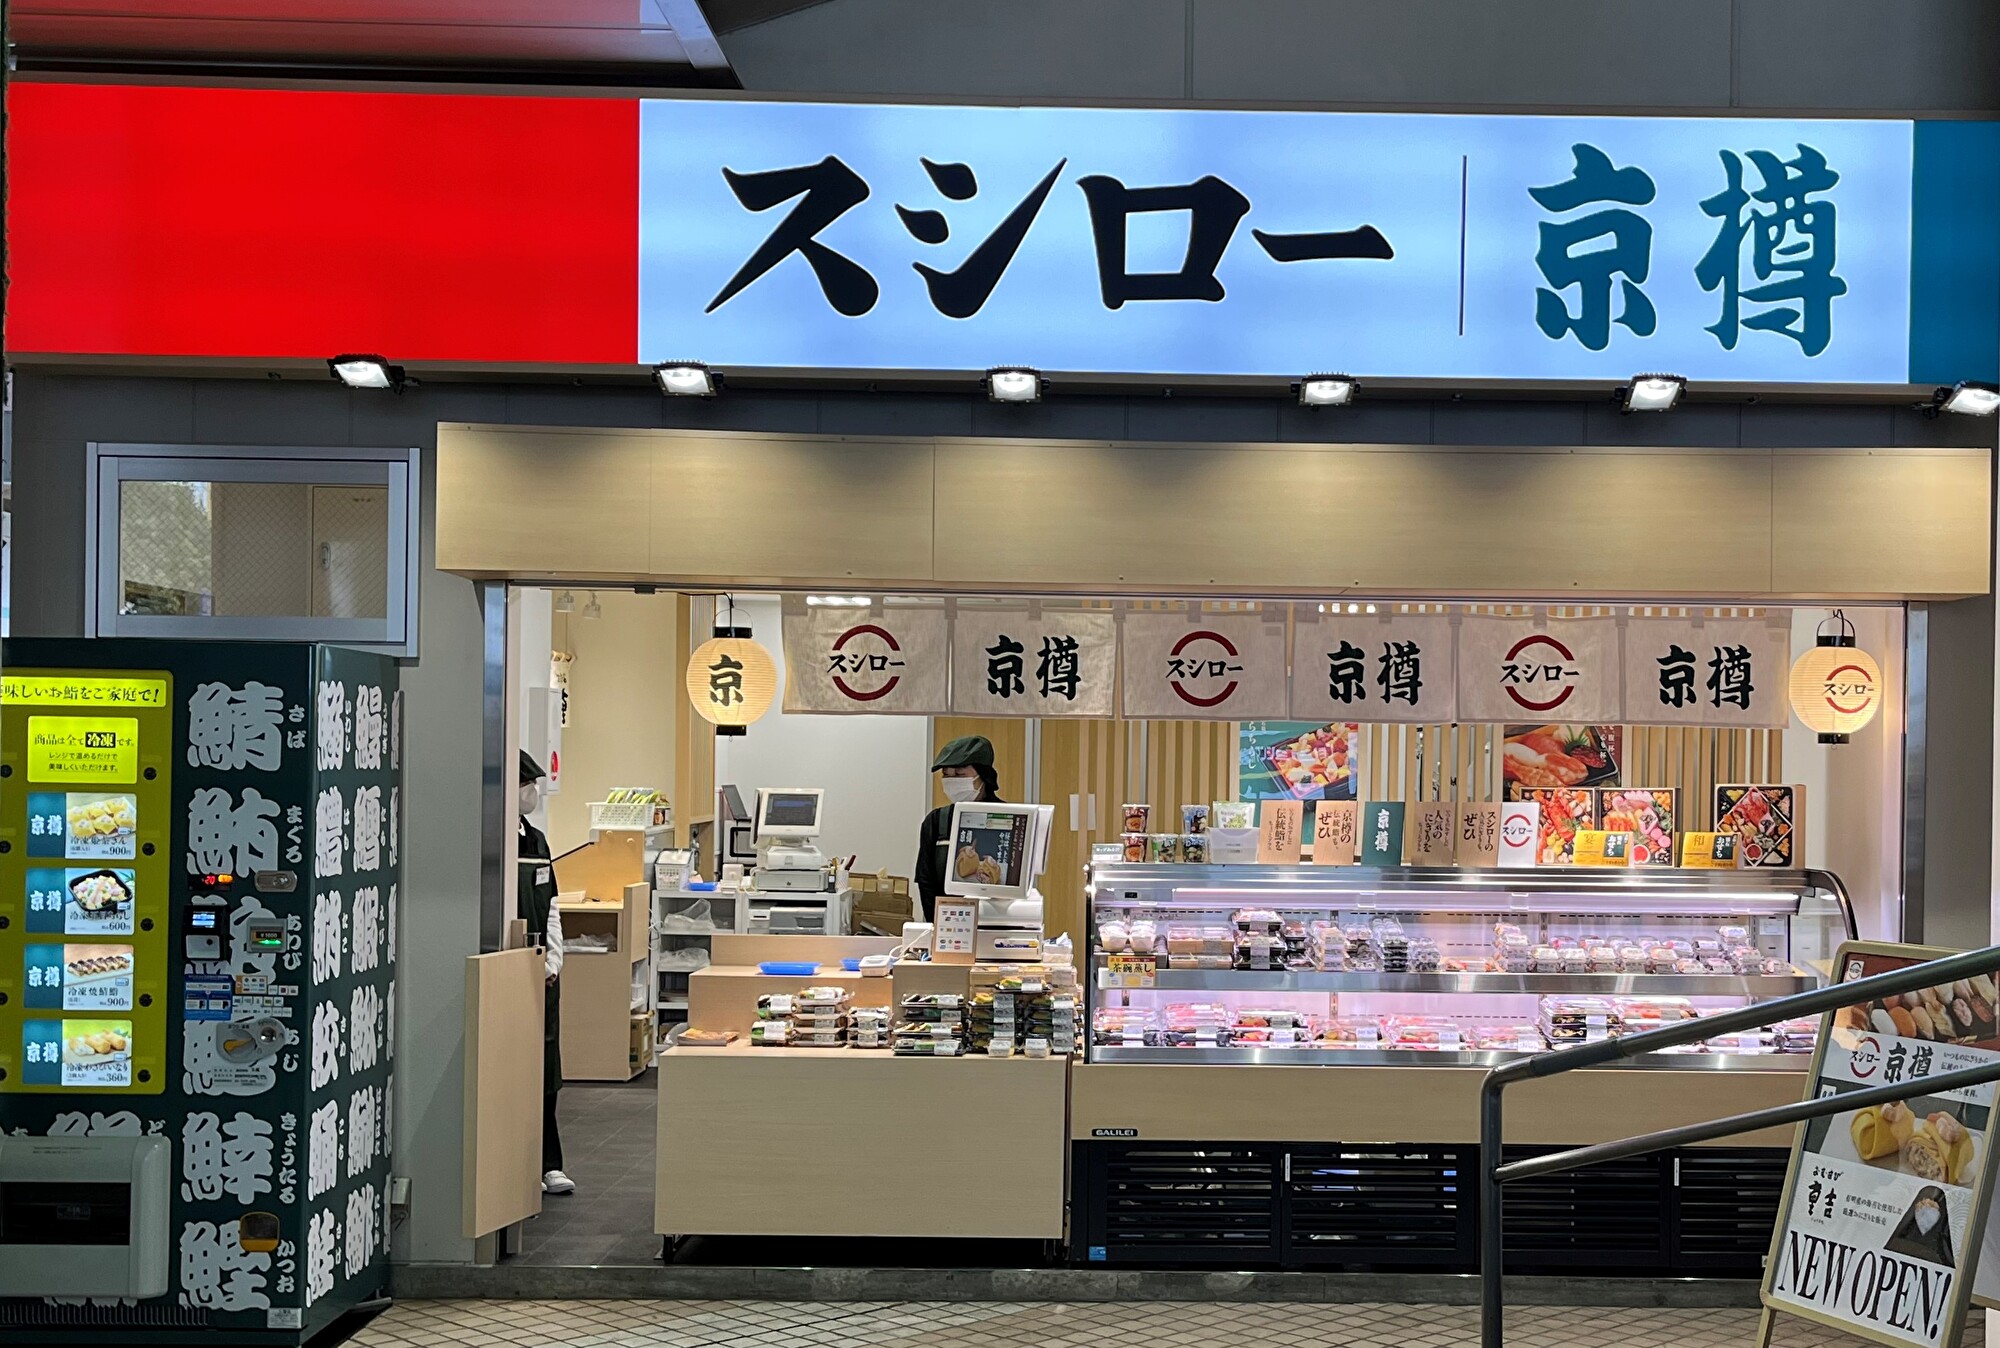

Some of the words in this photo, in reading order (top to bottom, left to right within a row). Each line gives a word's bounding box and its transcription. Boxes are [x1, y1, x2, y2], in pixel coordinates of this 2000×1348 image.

[705, 155, 1394, 319] スシロー
[1528, 143, 1847, 356] 京樽
[708, 653, 744, 706] 京
[827, 652, 906, 674] スシロー
[985, 635, 1081, 701] 京樽
[1166, 656, 1244, 679] スシロー
[1326, 639, 1424, 705] 京樽
[1500, 661, 1580, 686] スシロー
[1656, 642, 1755, 710] 京樽
[0, 685, 159, 703] 味しいお鮨をご家庭で!
[1824, 681, 1875, 698] スシロー
[187, 681, 284, 771] 鯖
[287, 704, 306, 749] さば
[30, 814, 63, 836] 京樽
[186, 787, 281, 878] 鮪
[286, 805, 304, 864] まぐろ
[1274, 807, 1287, 851] 伝統鮨を
[1318, 811, 1333, 839] ぜひ
[1340, 808, 1352, 844] 京樽の
[1375, 808, 1391, 852] 京樽
[1423, 812, 1433, 853] にぎりを
[1433, 809, 1444, 840] 人気の
[1464, 812, 1479, 840] ぜひ
[1485, 811, 1497, 852] スシローの
[1502, 826, 1534, 836] スシロー
[1607, 834, 1617, 857] おせち
[1716, 836, 1725, 859] おせち
[30, 890, 62, 911] 京樽
[28, 966, 60, 987] 京樽
[1113, 962, 1153, 974] 茶碗蒸し
[26, 1041, 59, 1063] 京樽
[1850, 1050, 1881, 1064] スシロー
[1095, 1129, 1134, 1137] GALILEI
[279, 1112, 297, 1204] きょうたる
[276, 1240, 296, 1293] かつお
[1778, 1230, 1857, 1309] NEW
[1851, 1250, 1952, 1340] OPEN!
